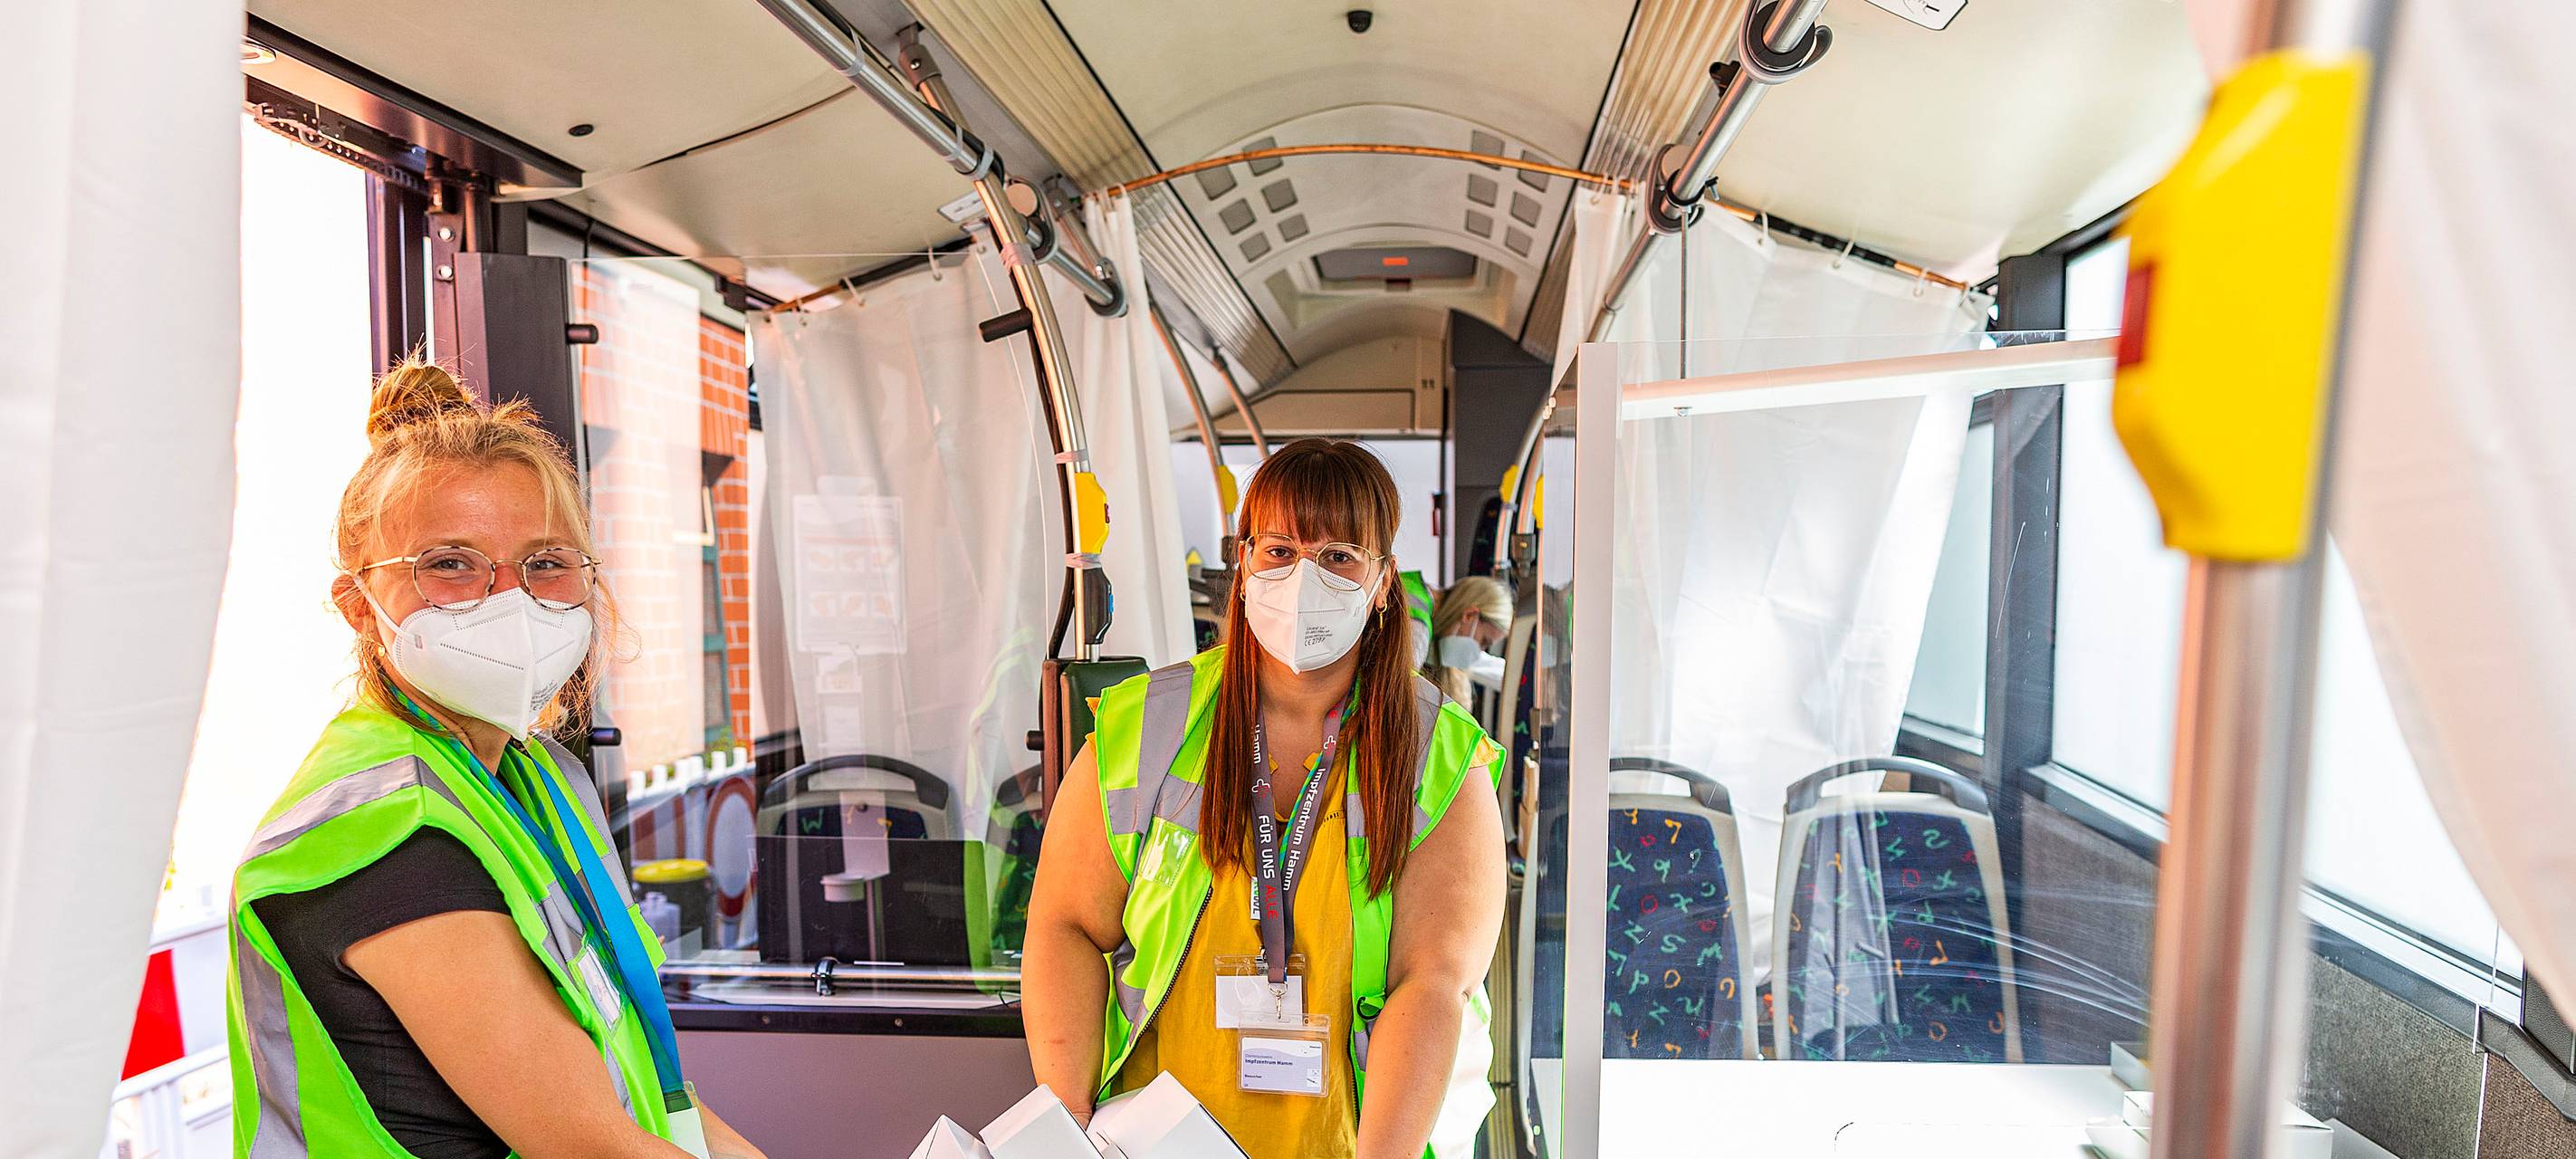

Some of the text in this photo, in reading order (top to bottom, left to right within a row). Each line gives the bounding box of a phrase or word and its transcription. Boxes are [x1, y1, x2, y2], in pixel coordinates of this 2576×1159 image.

[1258, 815, 1278, 921] FÜR UNS ALLE
[1282, 768, 1326, 891] Impfzentrum Hamm
